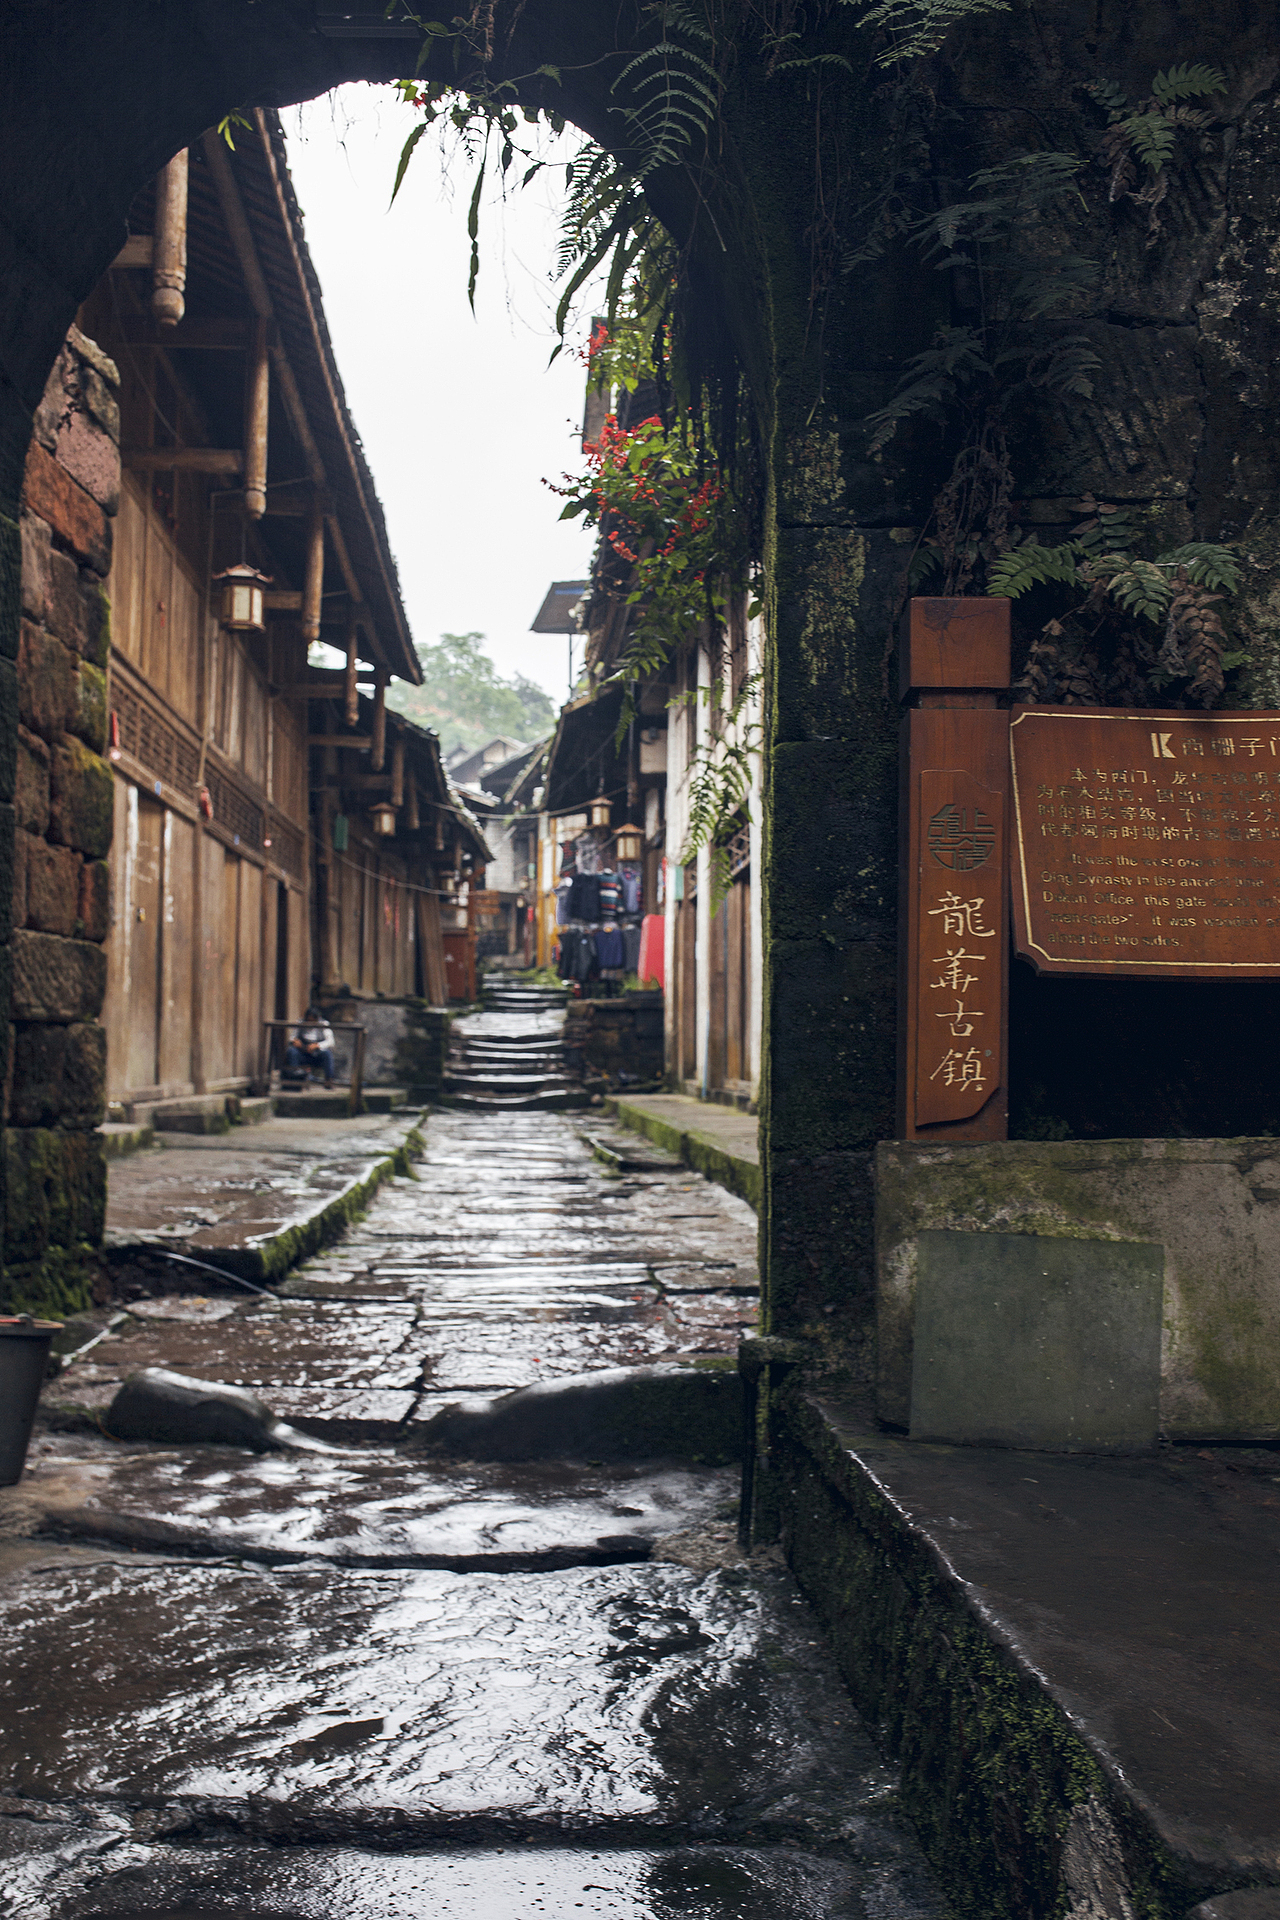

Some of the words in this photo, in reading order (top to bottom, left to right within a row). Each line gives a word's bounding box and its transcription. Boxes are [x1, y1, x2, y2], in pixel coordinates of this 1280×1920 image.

[1085, 855, 1113, 866] was
[1115, 854, 1139, 867] the
[1040, 870, 1074, 887] Qing
[1077, 872, 1133, 888] Dynasty
[1153, 875, 1176, 887] the
[1143, 894, 1171, 907] this
[1174, 896, 1207, 910] gate
[1168, 917, 1198, 928] was
[1047, 932, 1086, 946] along
[1113, 934, 1140, 946] two
